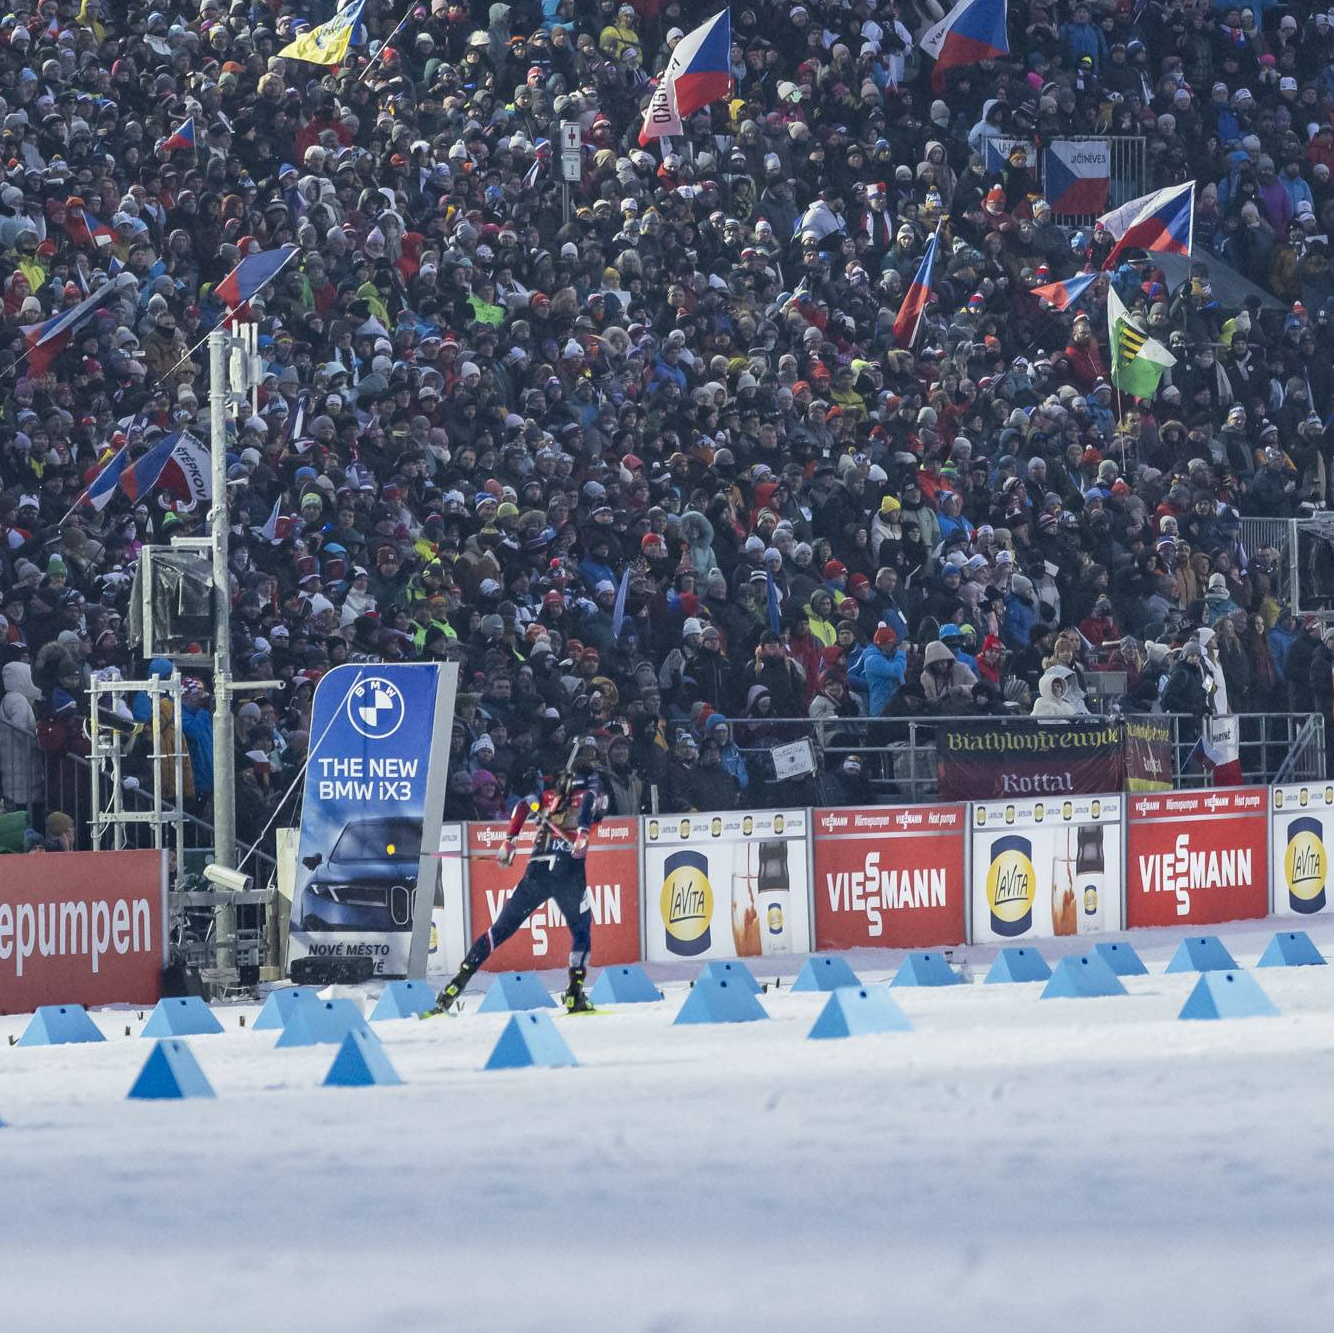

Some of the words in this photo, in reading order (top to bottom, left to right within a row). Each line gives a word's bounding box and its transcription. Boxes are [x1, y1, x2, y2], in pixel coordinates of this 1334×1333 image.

[354, 681, 396, 698] BMW
[318, 757, 363, 778] THE
[369, 757, 418, 778] NEW
[319, 781, 374, 801] BMW
[379, 781, 412, 801] iX3
[1002, 772, 1074, 793] Rottal
[1139, 834, 1252, 916] VIESSMANN
[826, 852, 946, 937] VIESSMANN
[308, 943, 344, 956] NOVÉ
[346, 943, 390, 956] MĚSTO
